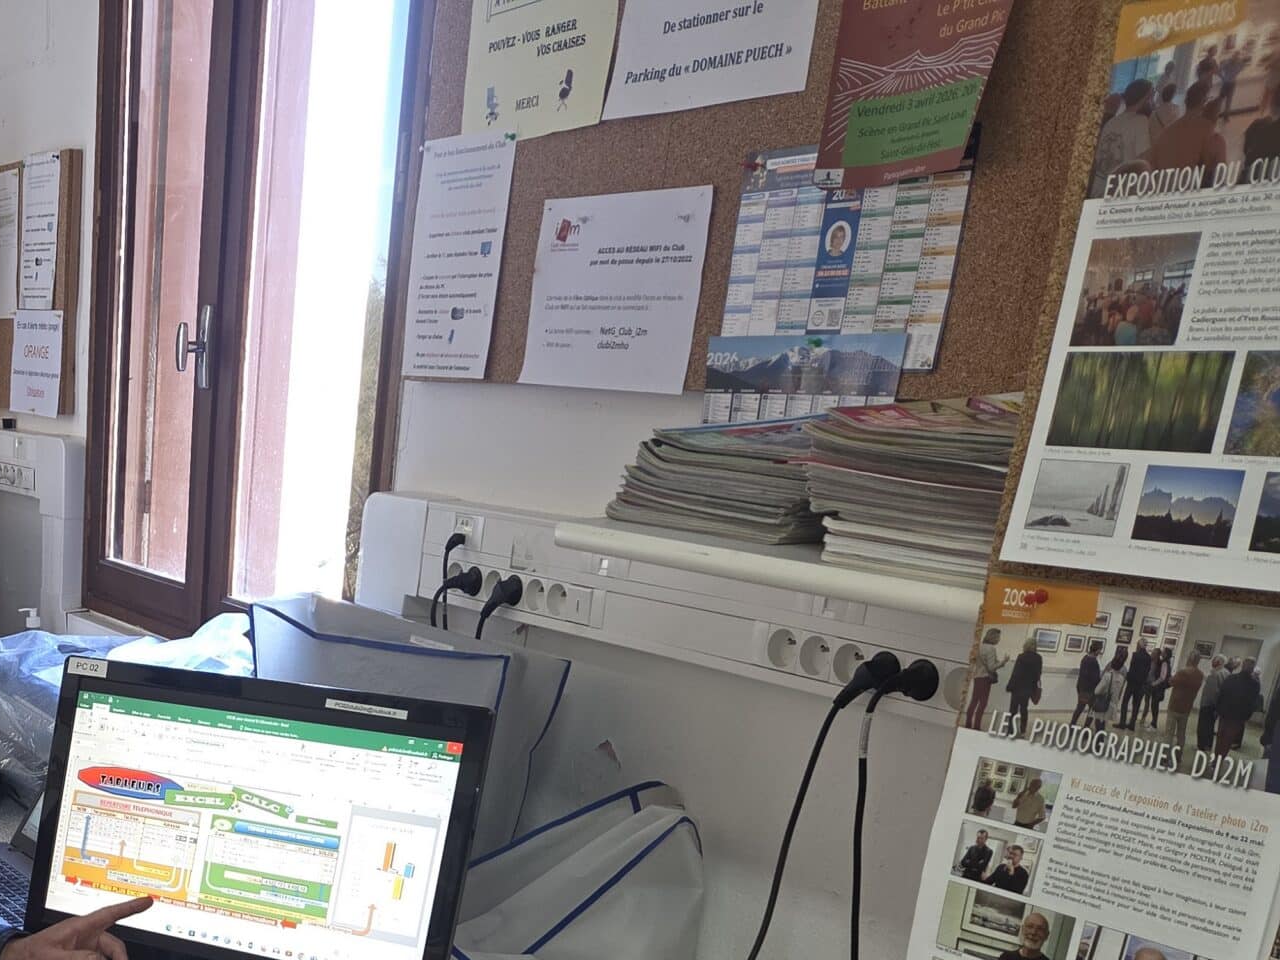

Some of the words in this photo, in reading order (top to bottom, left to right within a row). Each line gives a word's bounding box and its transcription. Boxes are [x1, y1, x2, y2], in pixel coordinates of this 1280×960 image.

[663, 21, 676, 34] De
[678, 9, 732, 31] stationner
[732, 5, 751, 19] sur
[753, 0, 764, 15] le
[939, 24, 953, 37] du
[955, 12, 990, 33] Grand
[489, 36, 516, 53] POUVEZ
[522, 29, 541, 44] VOUS
[545, 19, 577, 37] RANGER
[537, 43, 551, 57] VOS
[552, 34, 586, 53] CHAISES
[625, 68, 667, 84] Parking
[668, 64, 682, 78] du
[692, 51, 743, 74] DOMAINE
[745, 43, 784, 63] PUECH
[515, 95, 539, 111] MERCI
[857, 101, 905, 118] Vendredi
[1104, 165, 1205, 200] EXPOSITION
[1213, 160, 1241, 190] DU
[76, 662, 88, 670] PC
[90, 664, 99, 672] 02
[988, 710, 1021, 739] LES
[1029, 718, 1181, 773] PHOTOGRAPHES
[100, 775, 161, 793] TABLEURS
[1110, 785, 1121, 798] de
[1122, 788, 1170, 812] l'exposition
[1171, 800, 1183, 813] de
[1185, 803, 1218, 822] l'atelier
[1220, 812, 1247, 831] photo
